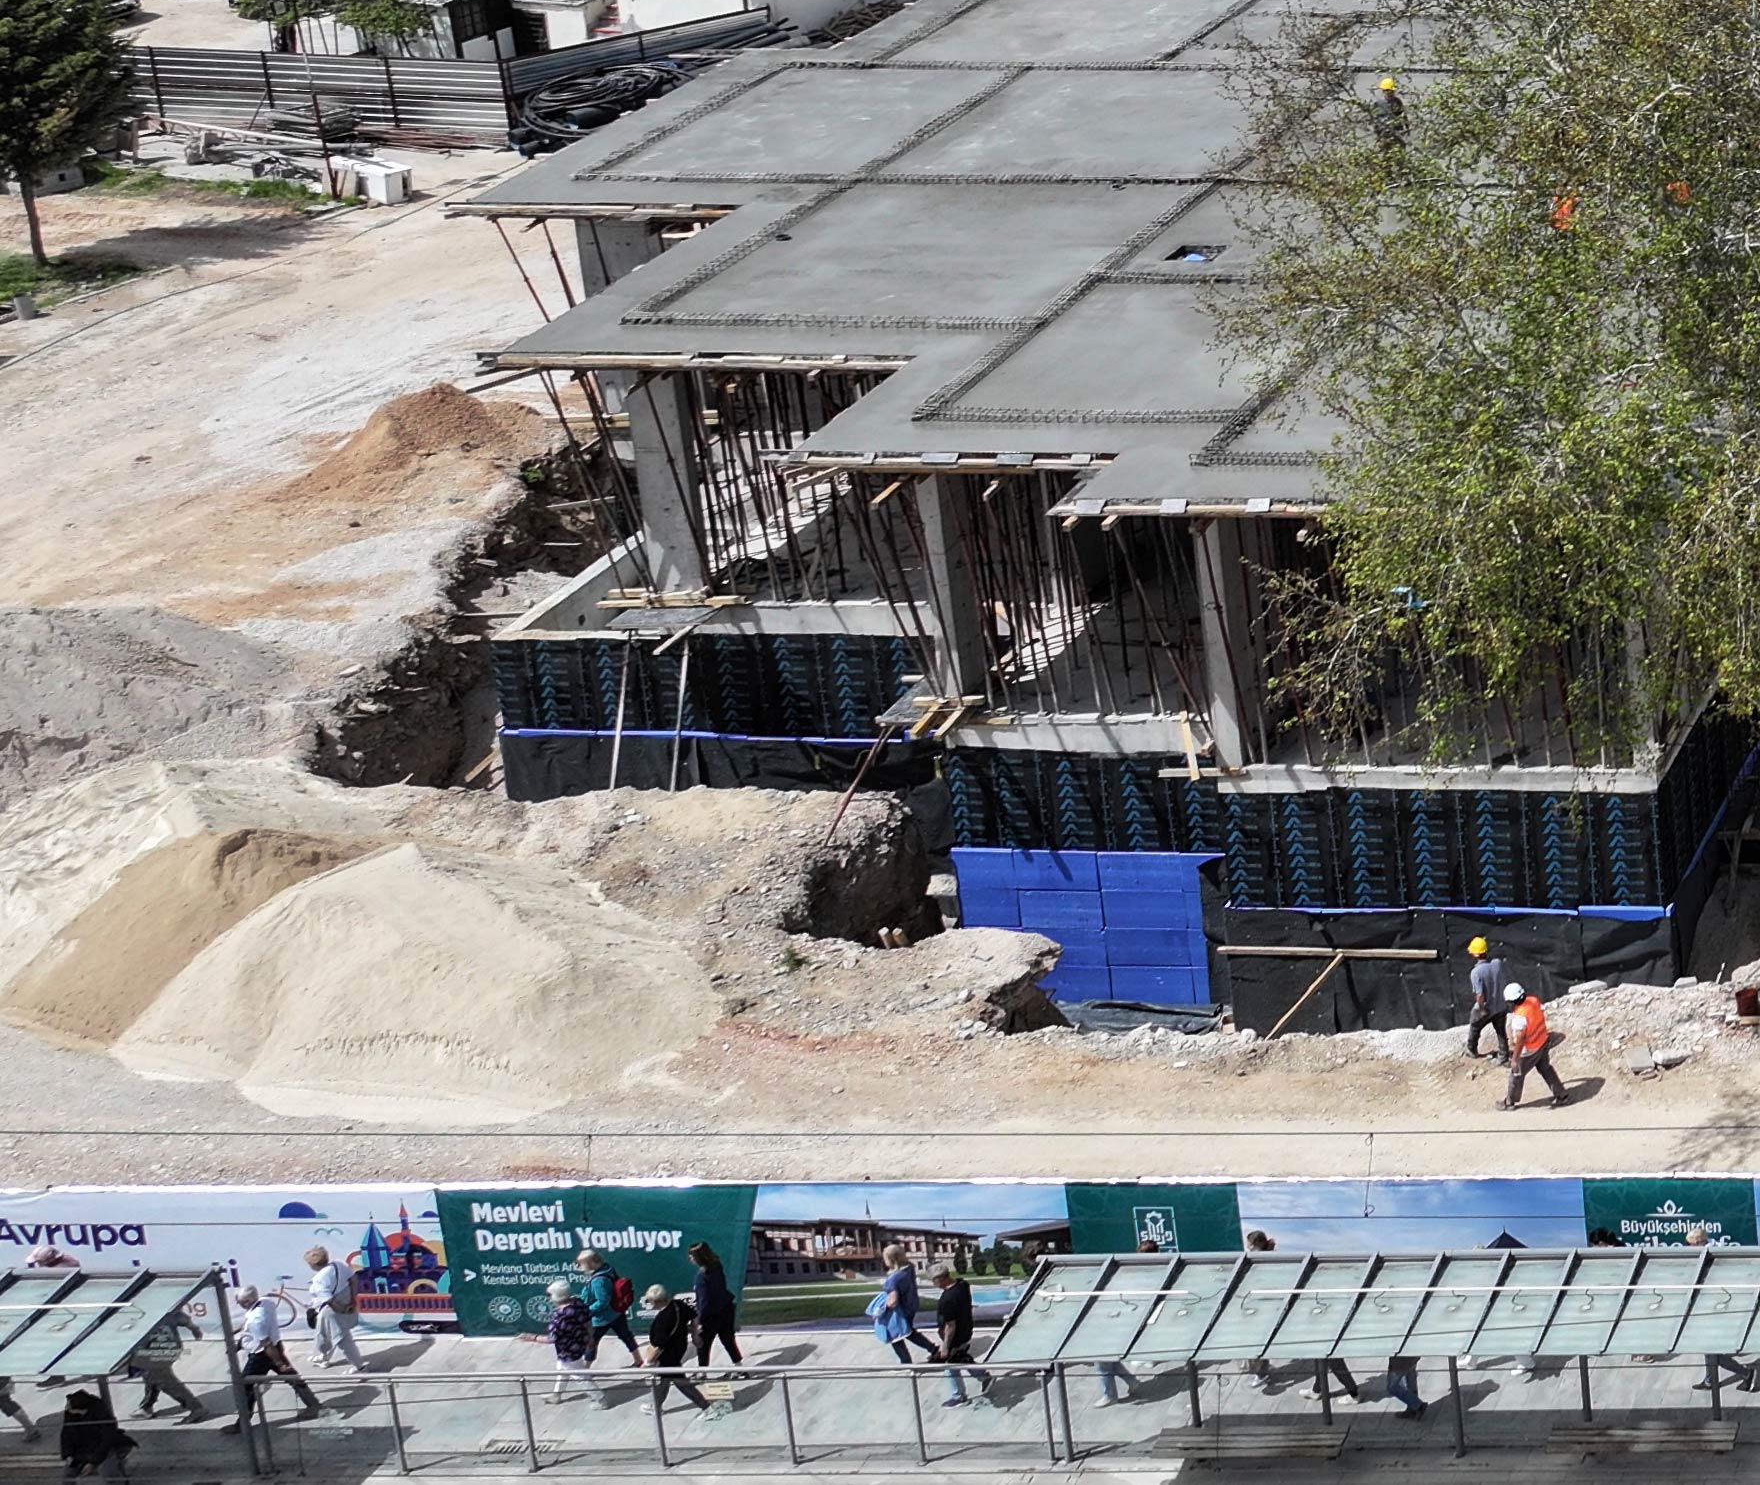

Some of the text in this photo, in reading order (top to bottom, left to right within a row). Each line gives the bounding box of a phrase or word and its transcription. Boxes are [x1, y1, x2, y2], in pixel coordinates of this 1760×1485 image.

[471, 1200, 564, 1223] Mevlevi
[0, 1218, 147, 1252] Avrupa
[1620, 1219, 1722, 1235] Büyükşehirden
[475, 1226, 683, 1254] Dergahı Yapılıyor
[524, 1262, 560, 1273] Türbesi
